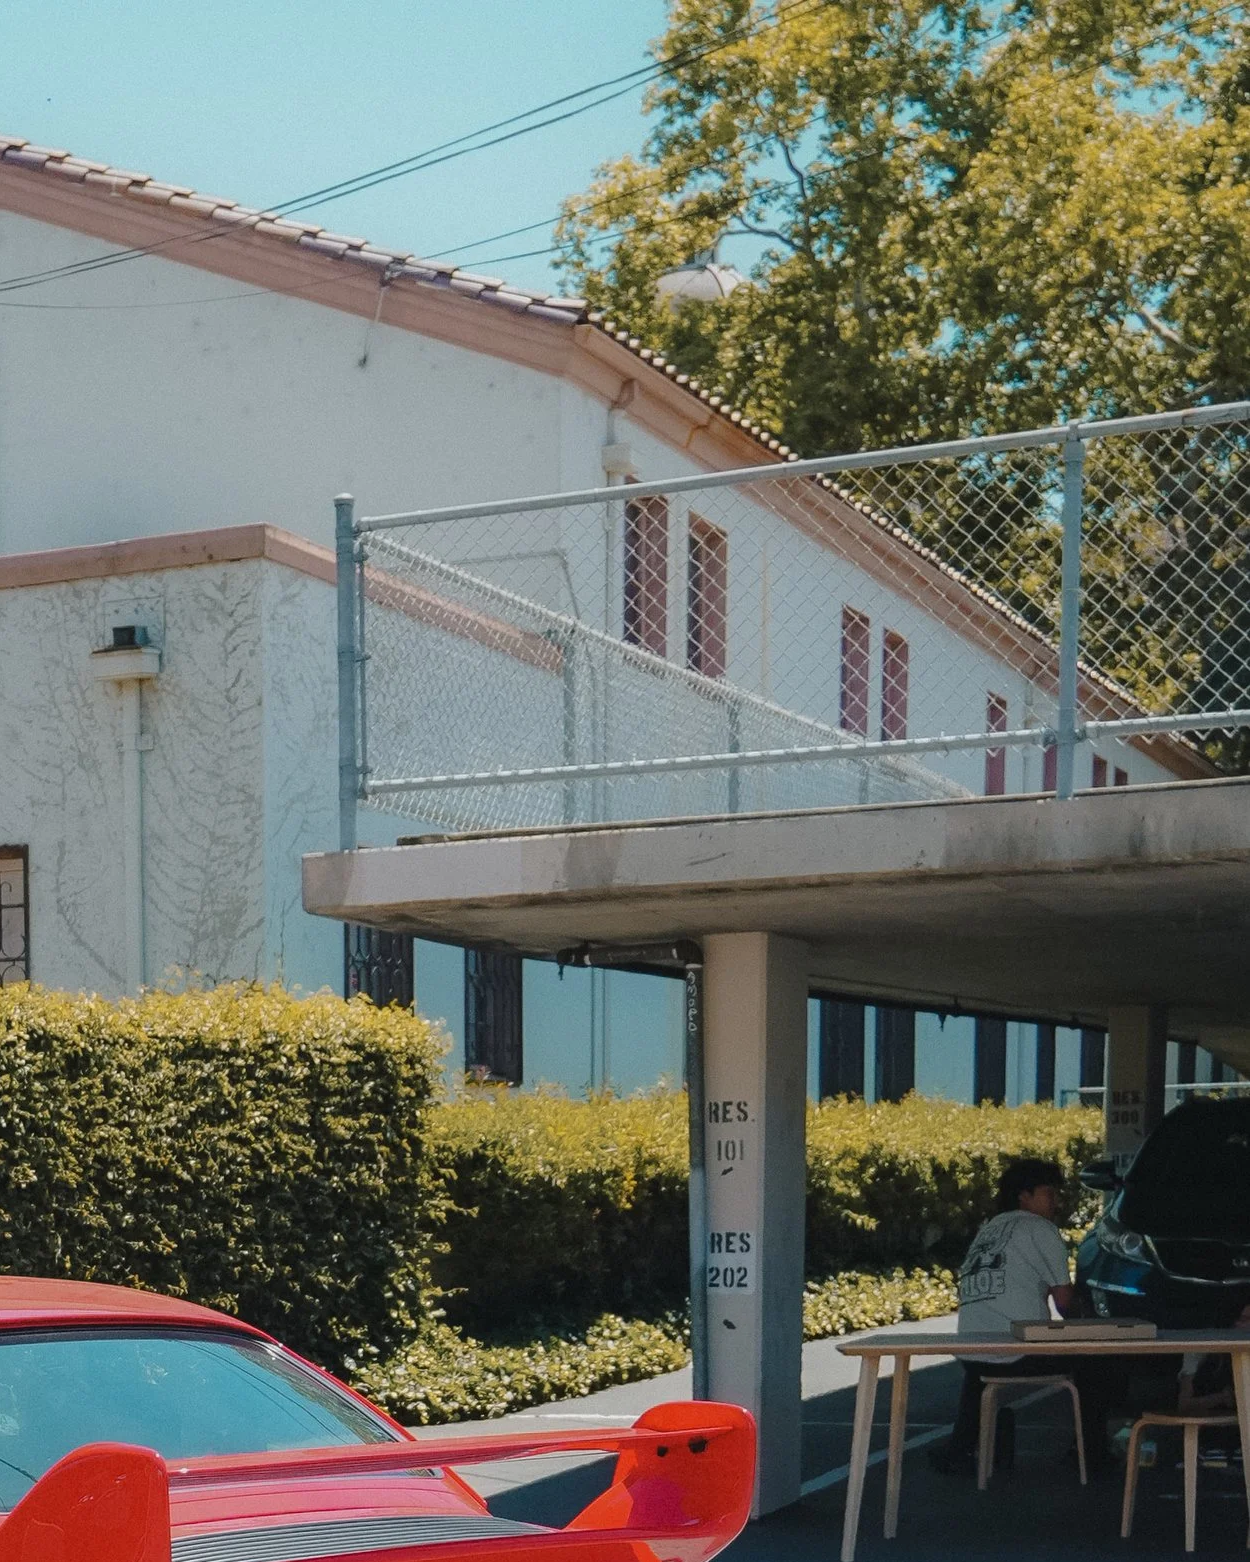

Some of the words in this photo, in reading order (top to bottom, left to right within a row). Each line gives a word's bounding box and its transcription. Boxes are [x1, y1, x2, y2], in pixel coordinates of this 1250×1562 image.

[708, 1100, 755, 1123] RES.
[716, 1139, 744, 1161] 101
[710, 1231, 751, 1254] RES
[708, 1266, 748, 1288] 202
